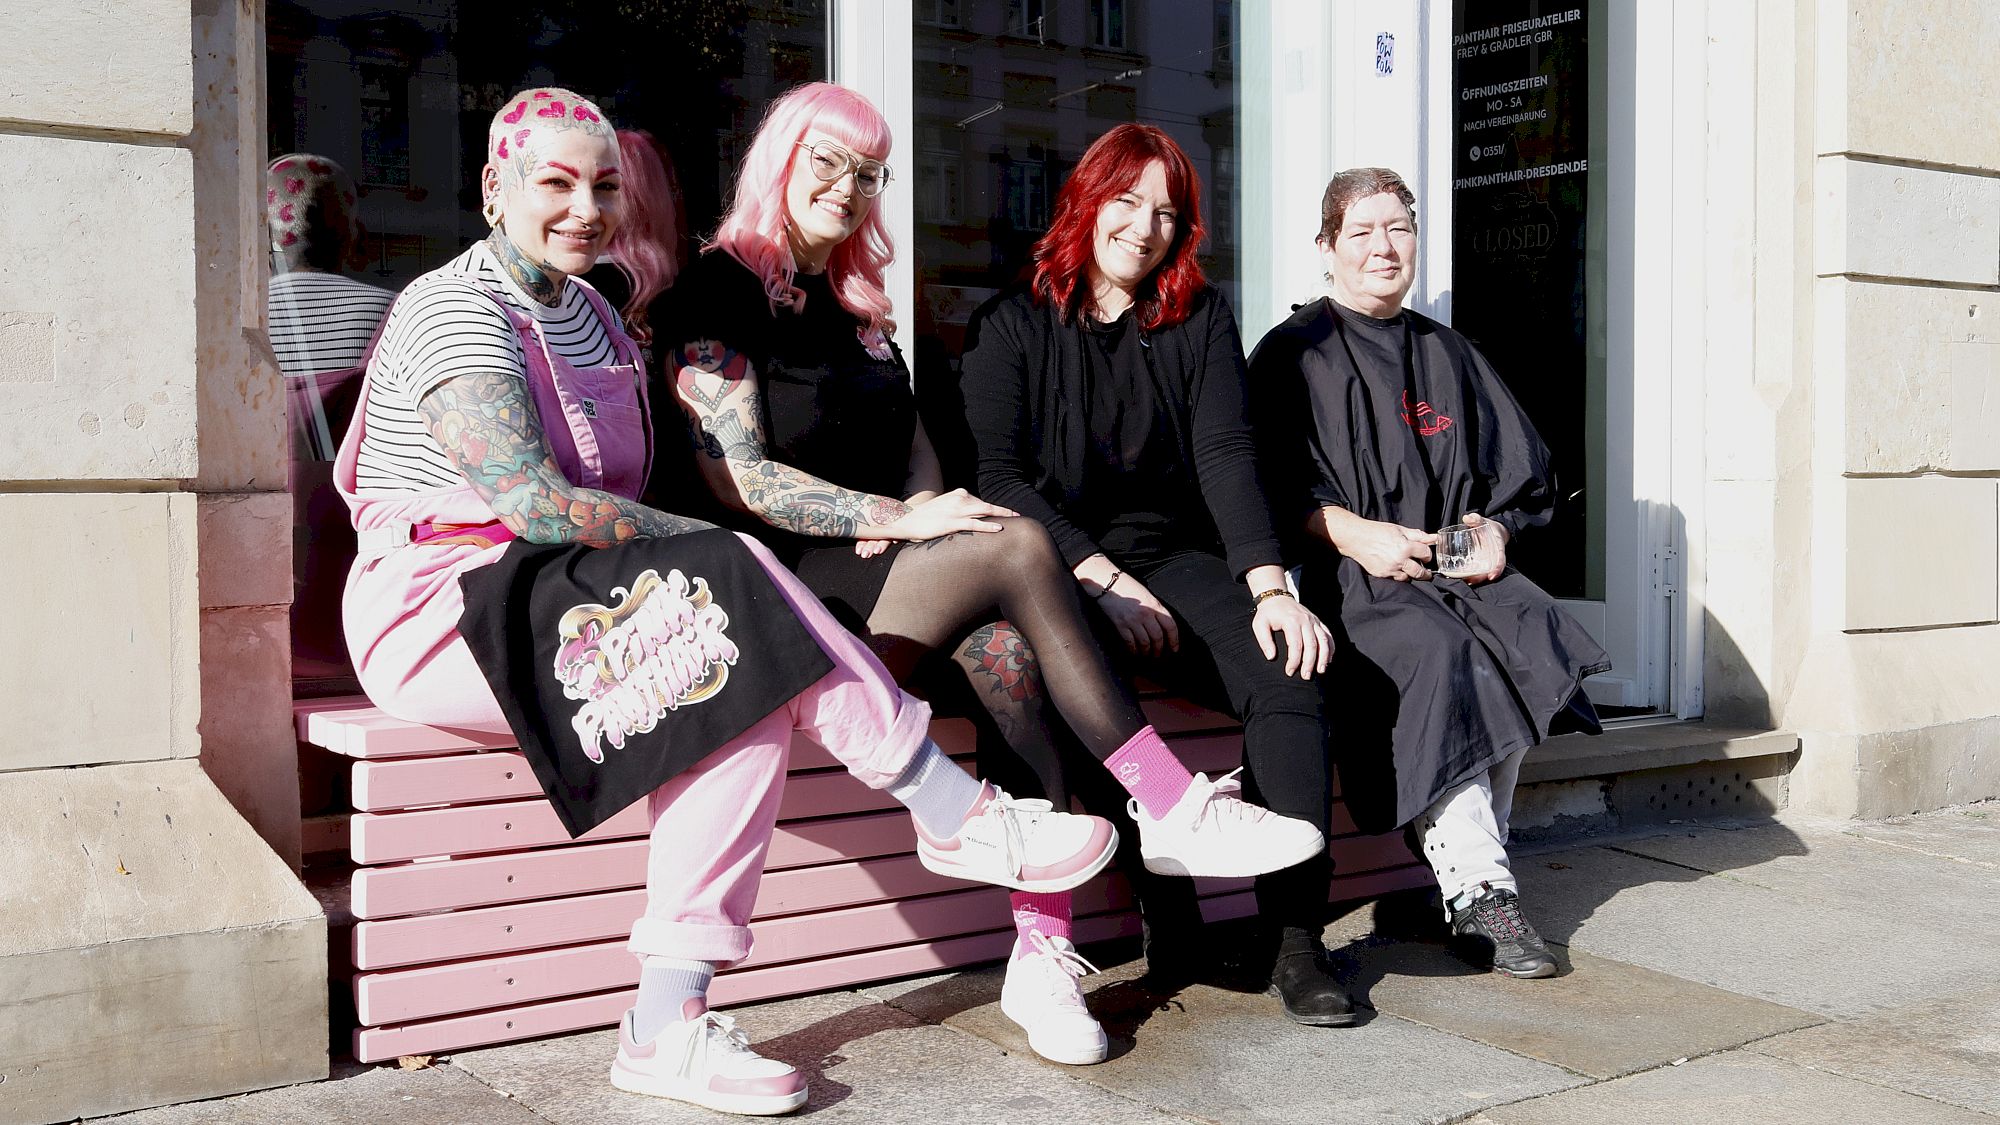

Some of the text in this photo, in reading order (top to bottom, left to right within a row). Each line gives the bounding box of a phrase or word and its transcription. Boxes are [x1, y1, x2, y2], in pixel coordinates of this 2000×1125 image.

[1453, 9, 1581, 46] PANTHAIR FRISEURATELIER
[1457, 30, 1553, 60] FREY & GRADLER GBR
[1462, 75, 1548, 100] ÖFFNUNGSZEITEN
[1486, 100, 1503, 112] MO
[1510, 96, 1523, 108] SA
[1463, 109, 1547, 132] NACH VEREINBARUNG
[1483, 143, 1506, 157] 0351/
